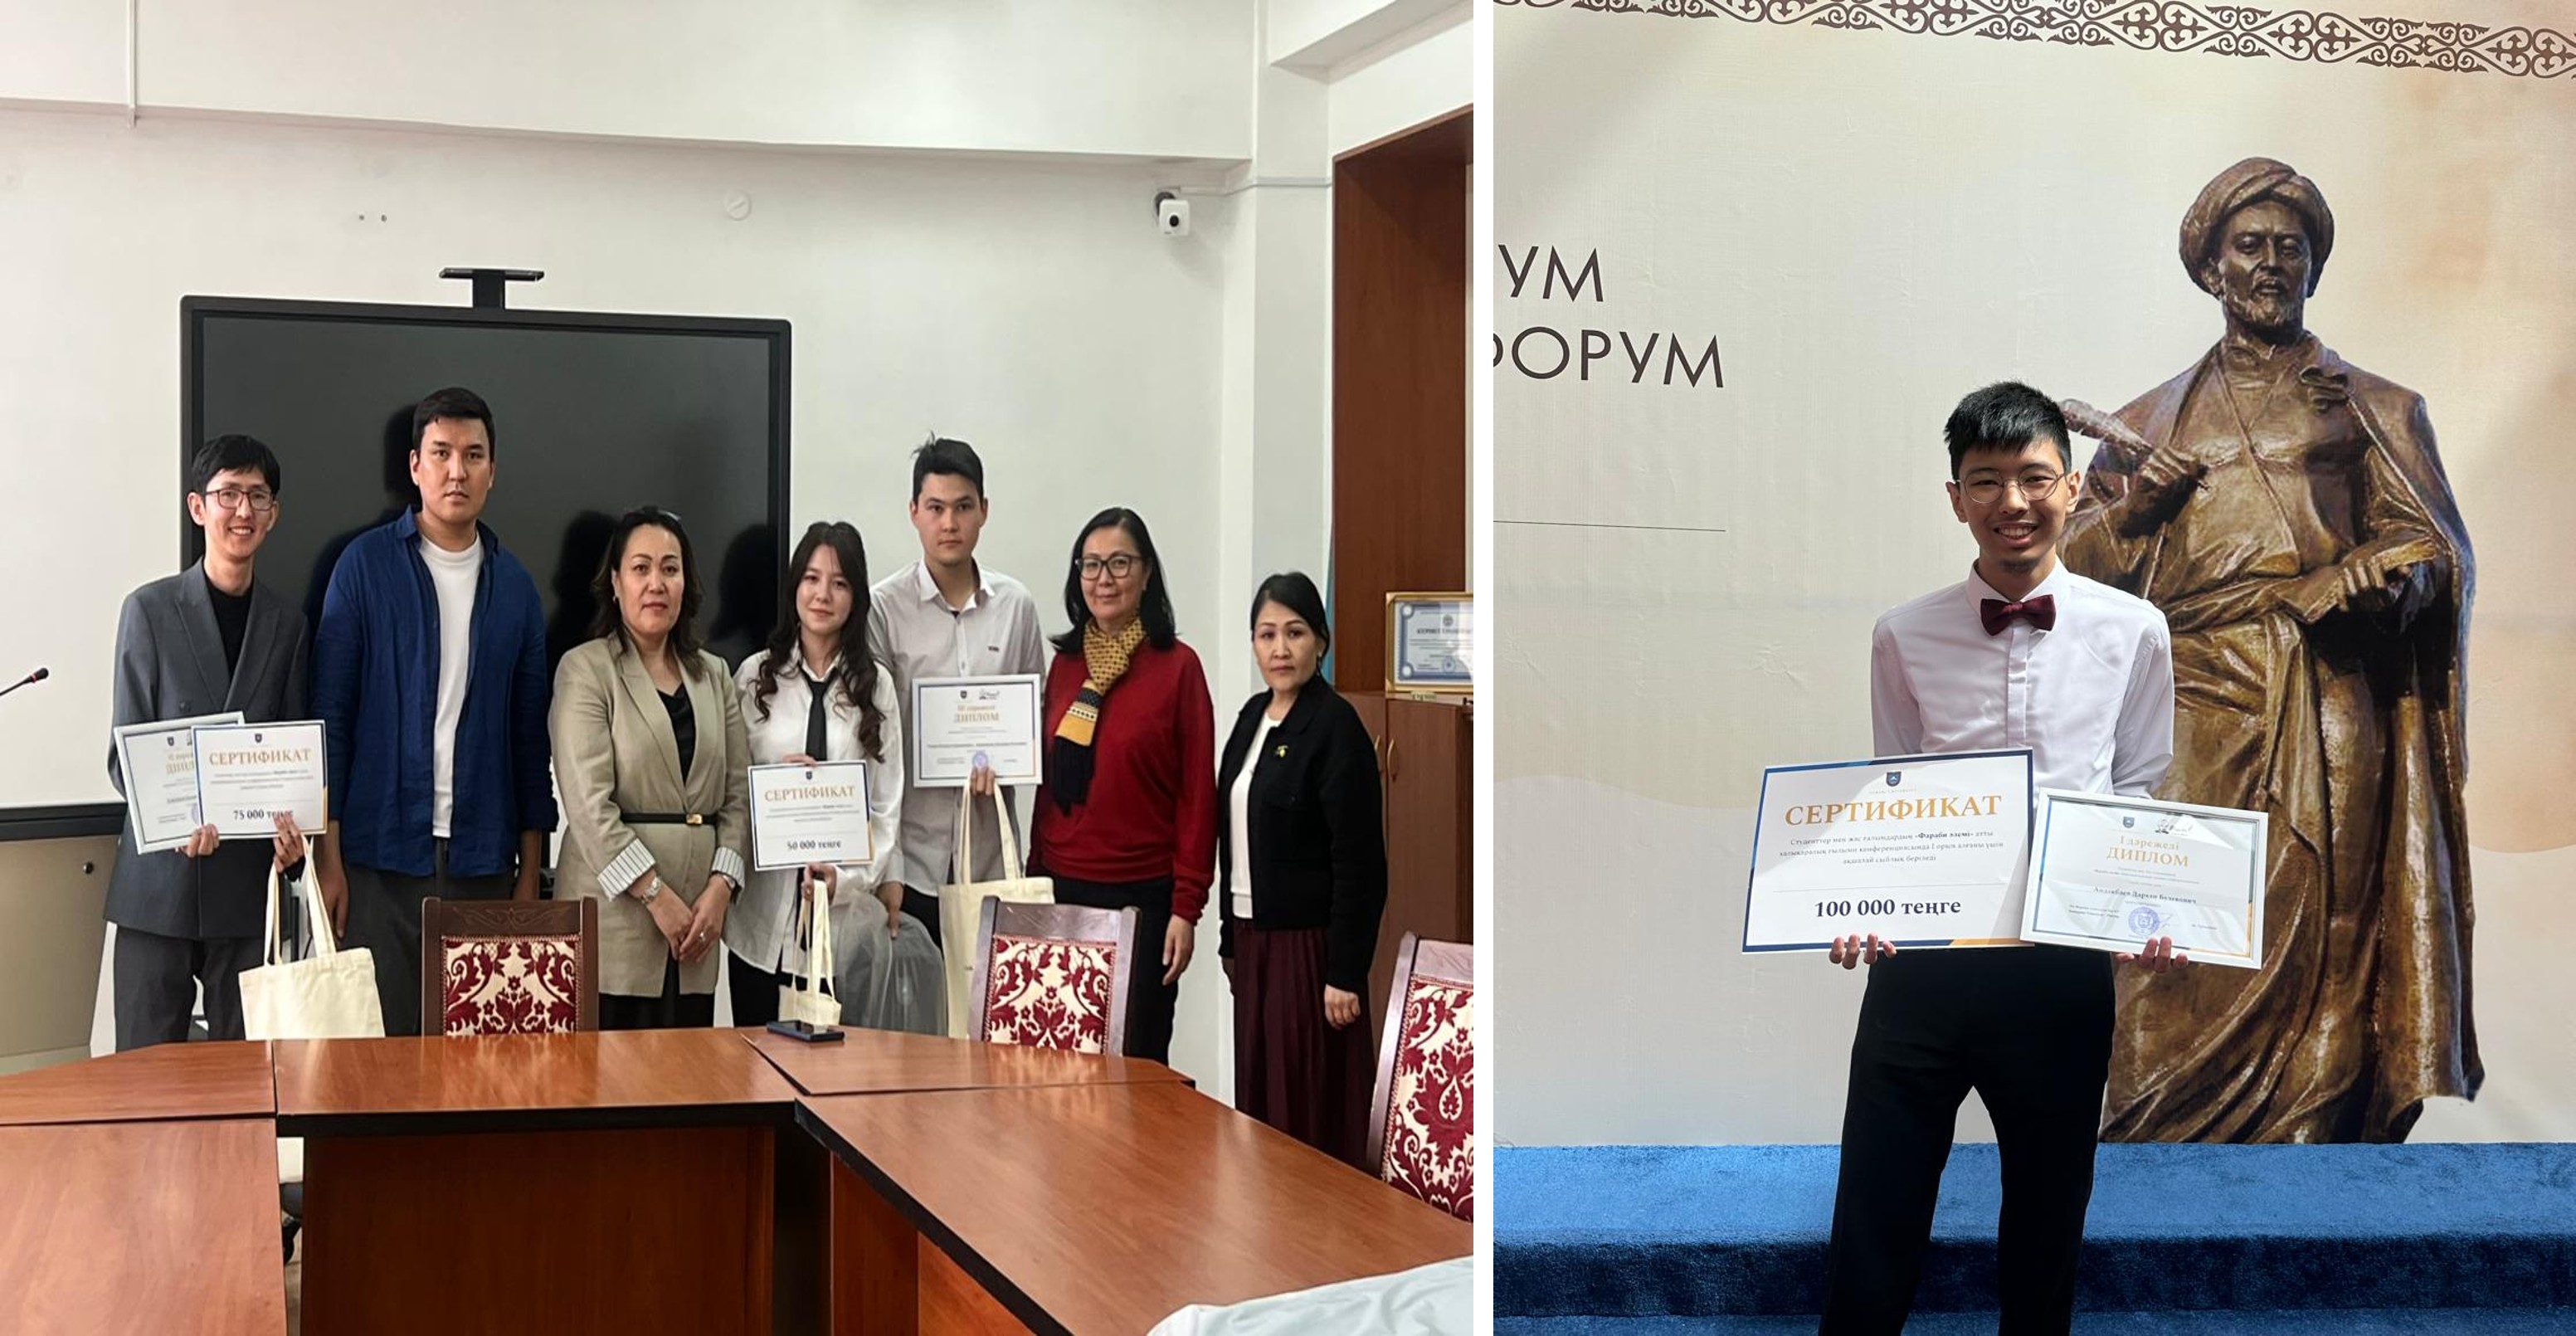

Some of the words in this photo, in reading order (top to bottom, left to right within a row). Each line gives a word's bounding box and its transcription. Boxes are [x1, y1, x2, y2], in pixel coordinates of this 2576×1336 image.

[209, 748, 311, 765] СЕРТИФИКАТ
[764, 786, 855, 802] СЕРТИФИКАТ
[233, 810, 245, 820] 75
[247, 808, 264, 819] 000
[1785, 795, 2002, 826] СЕРТИФИКАТ
[2106, 846, 2189, 868] ДИПЛОМ
[1814, 901, 1852, 918] 100
[1858, 899, 1896, 916] 000
[1901, 900, 1961, 917] теңге
